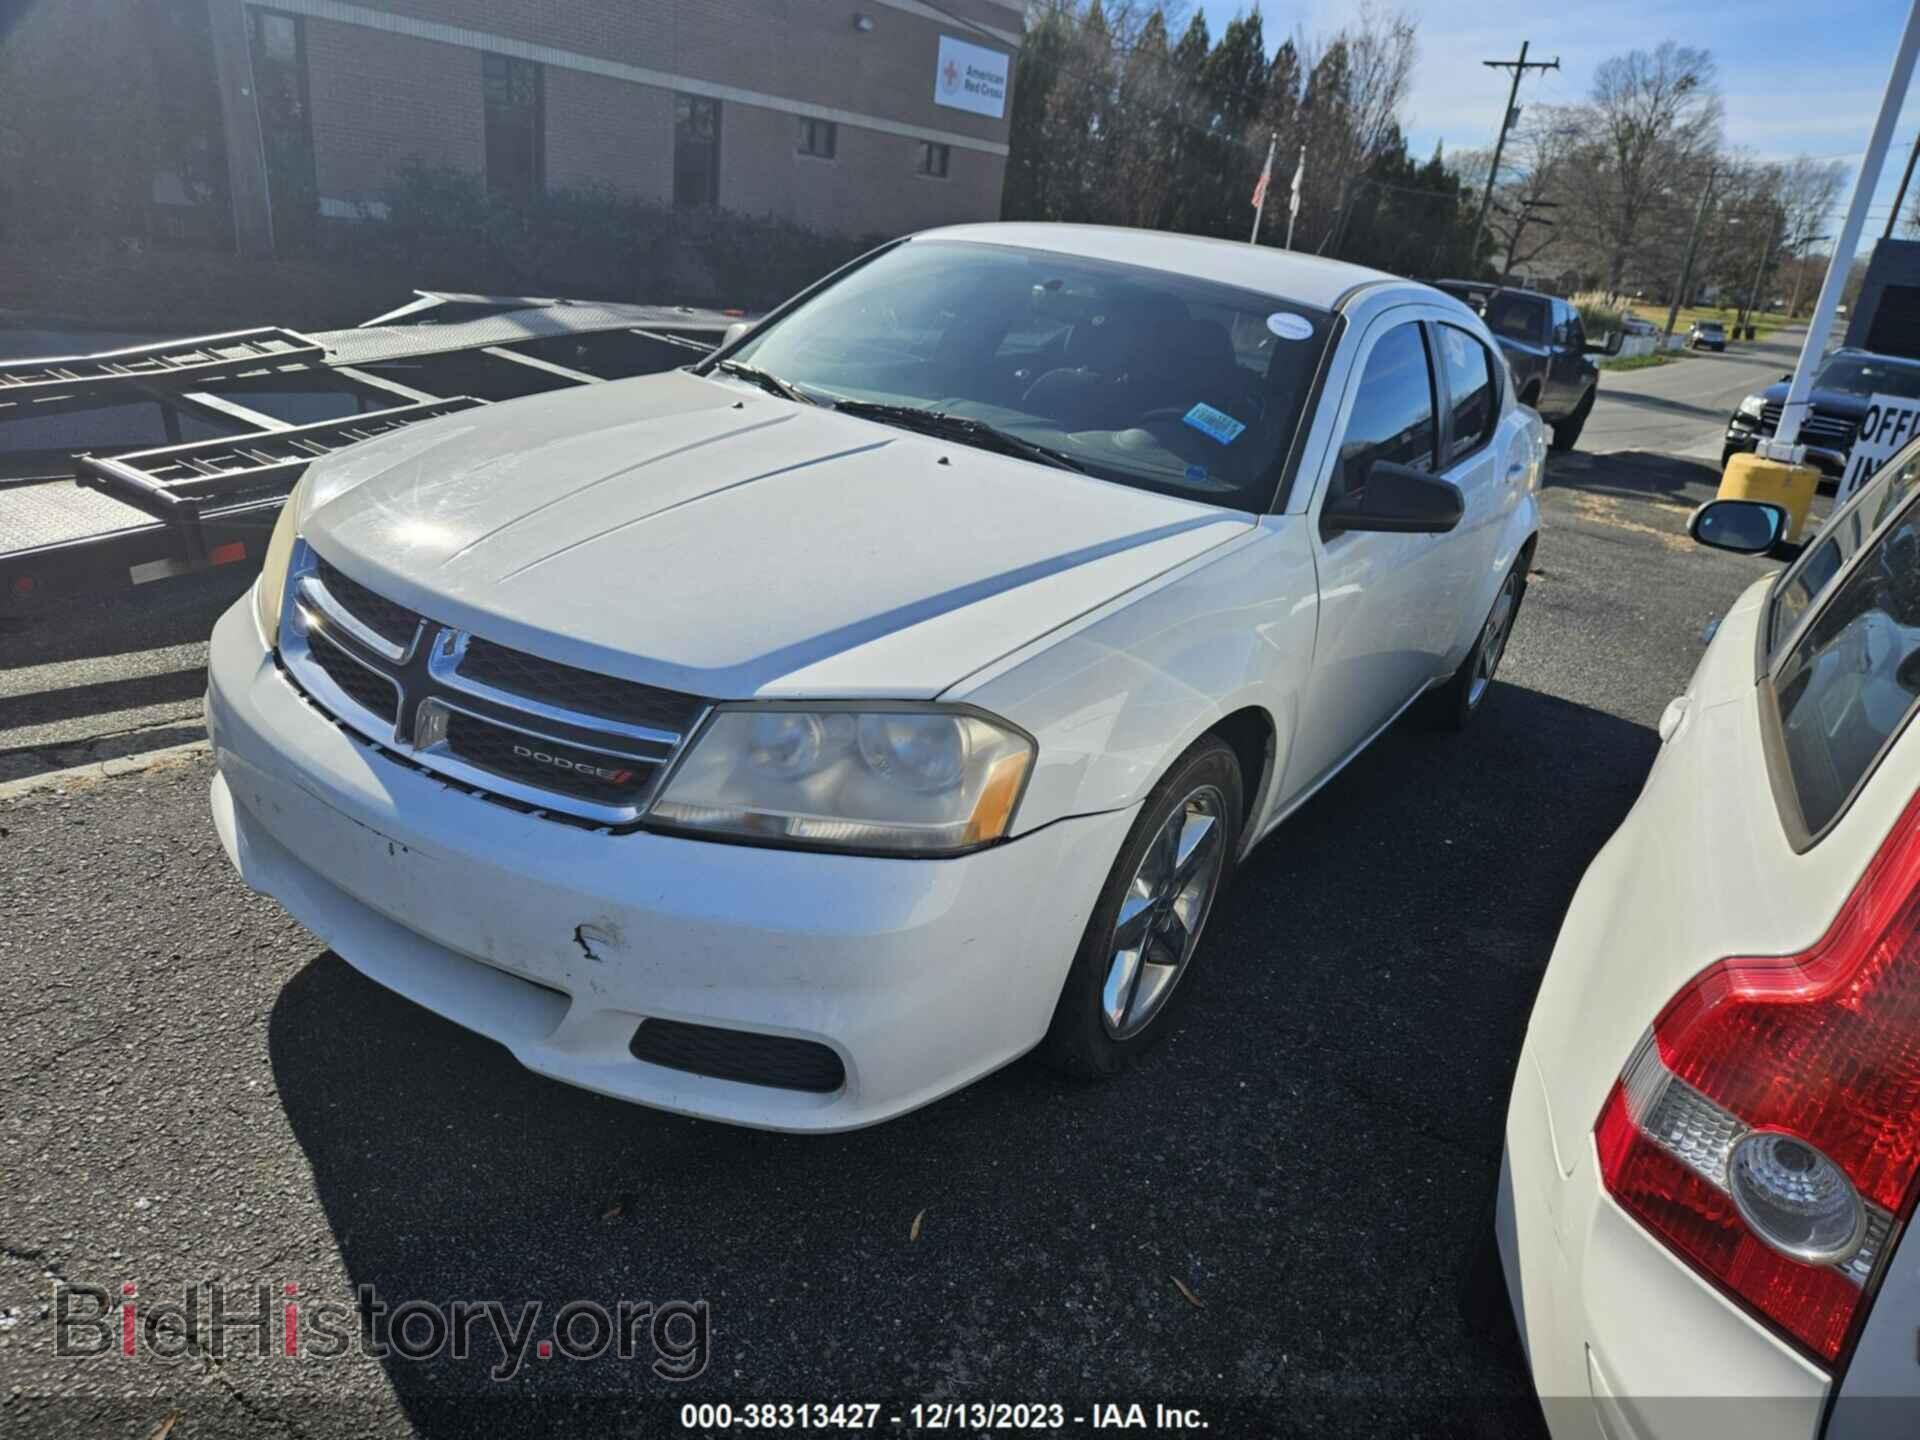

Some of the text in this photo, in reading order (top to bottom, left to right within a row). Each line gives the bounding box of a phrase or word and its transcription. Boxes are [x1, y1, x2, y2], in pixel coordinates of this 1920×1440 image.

[965, 64, 1004, 85] American
[964, 78, 1003, 99] Red Cross
[513, 745, 612, 780] DODGE
